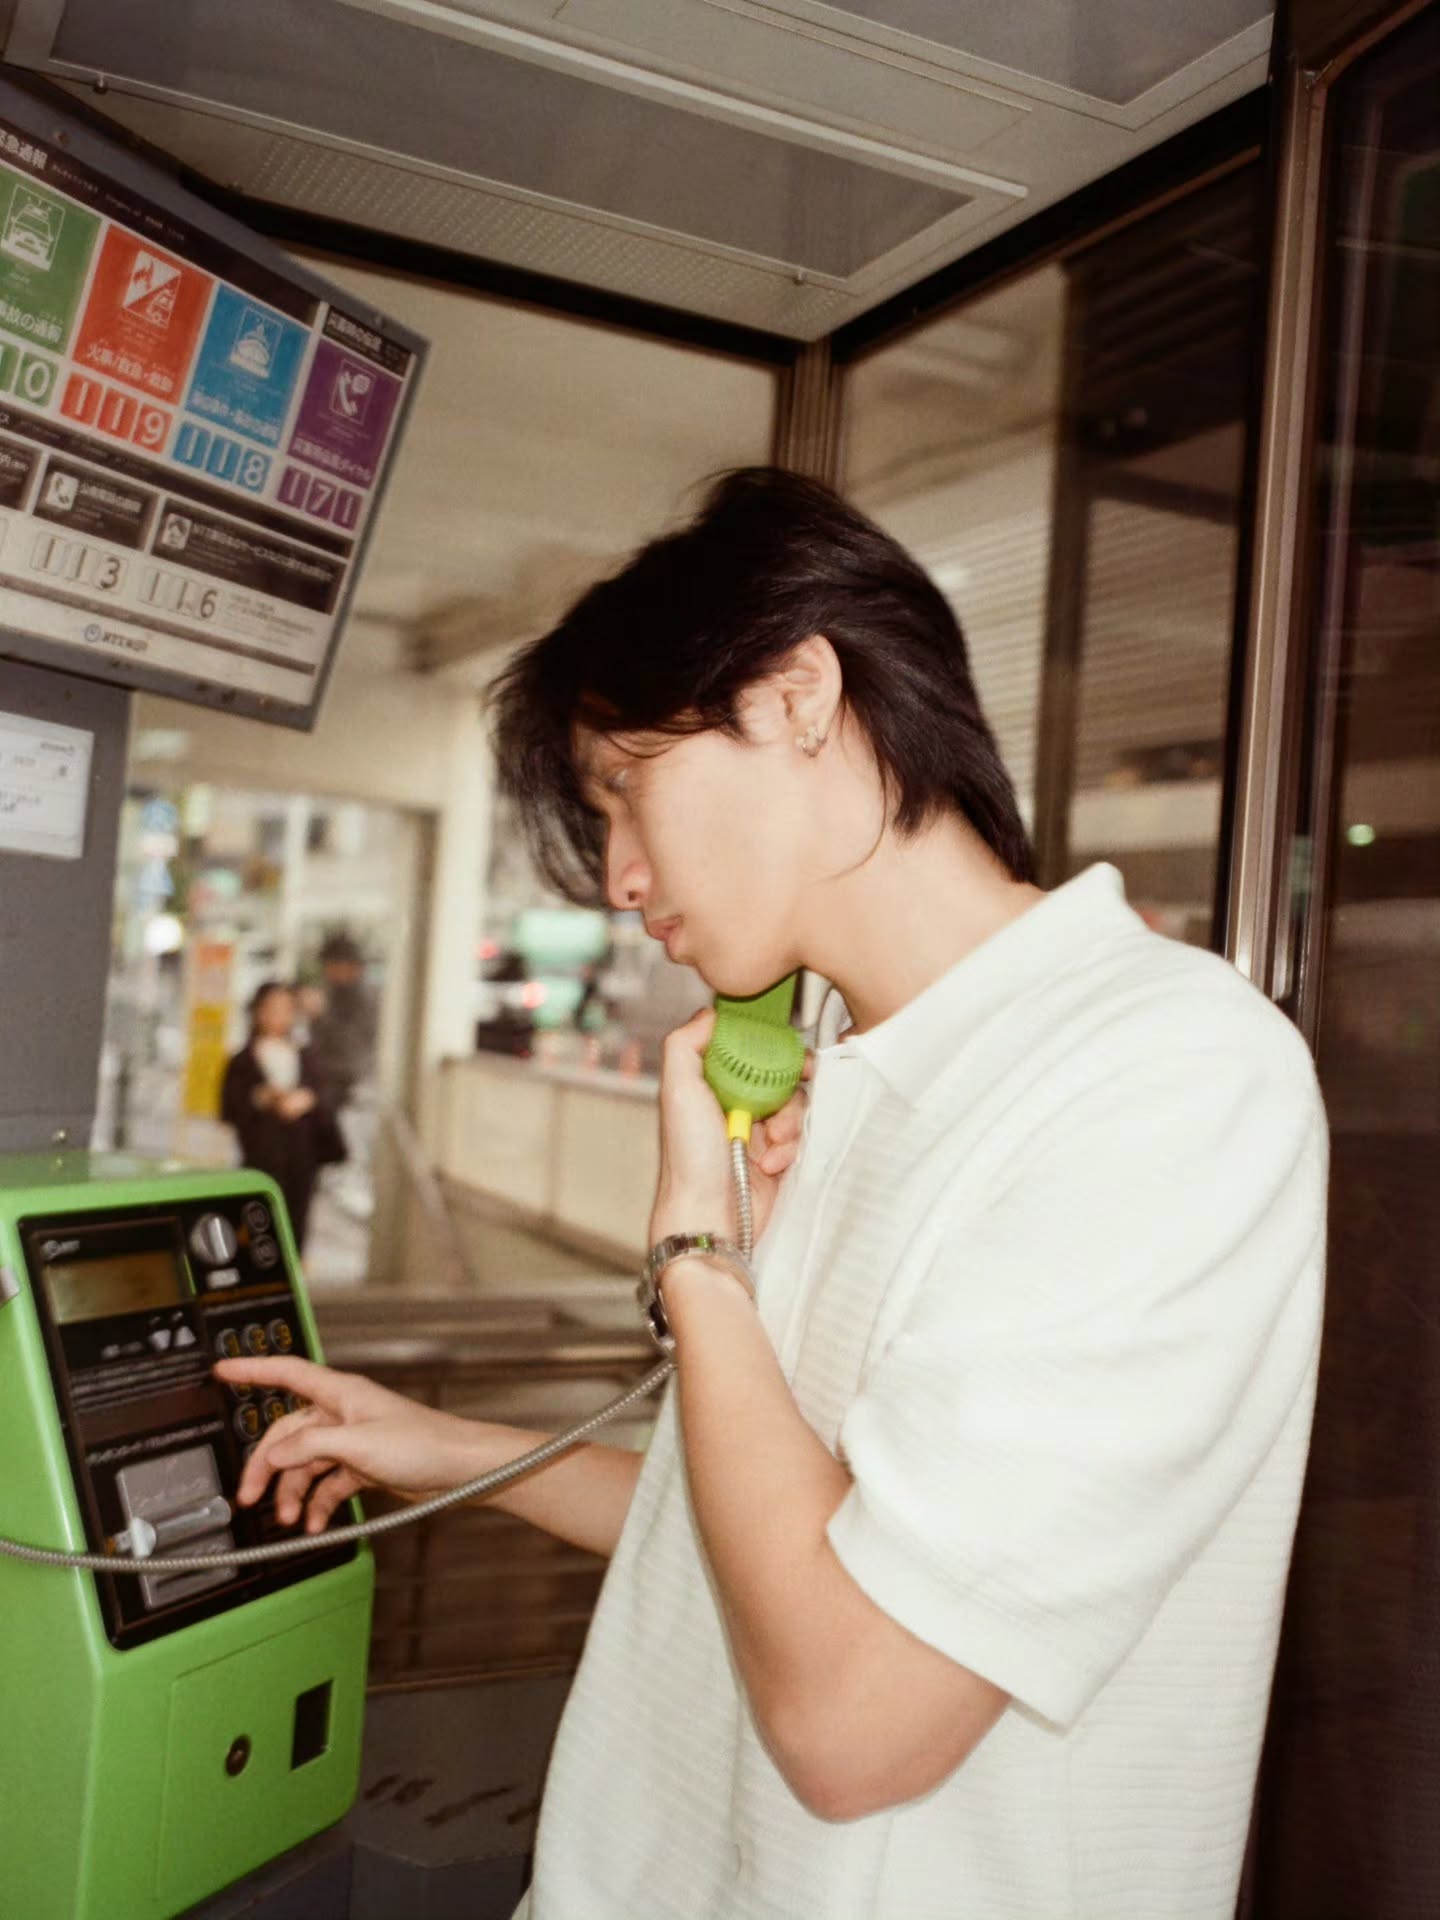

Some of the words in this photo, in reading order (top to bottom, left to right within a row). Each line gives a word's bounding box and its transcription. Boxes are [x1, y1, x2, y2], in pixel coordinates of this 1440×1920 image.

[75, 381, 165, 445] 119
[186, 428, 264, 486] 118
[289, 472, 354, 524] 171
[43, 537, 121, 589] 113
[149, 572, 217, 619] 116
[253, 1329, 267, 1350] 2
[279, 1325, 292, 1348] 3
[244, 1408, 258, 1434] 7
